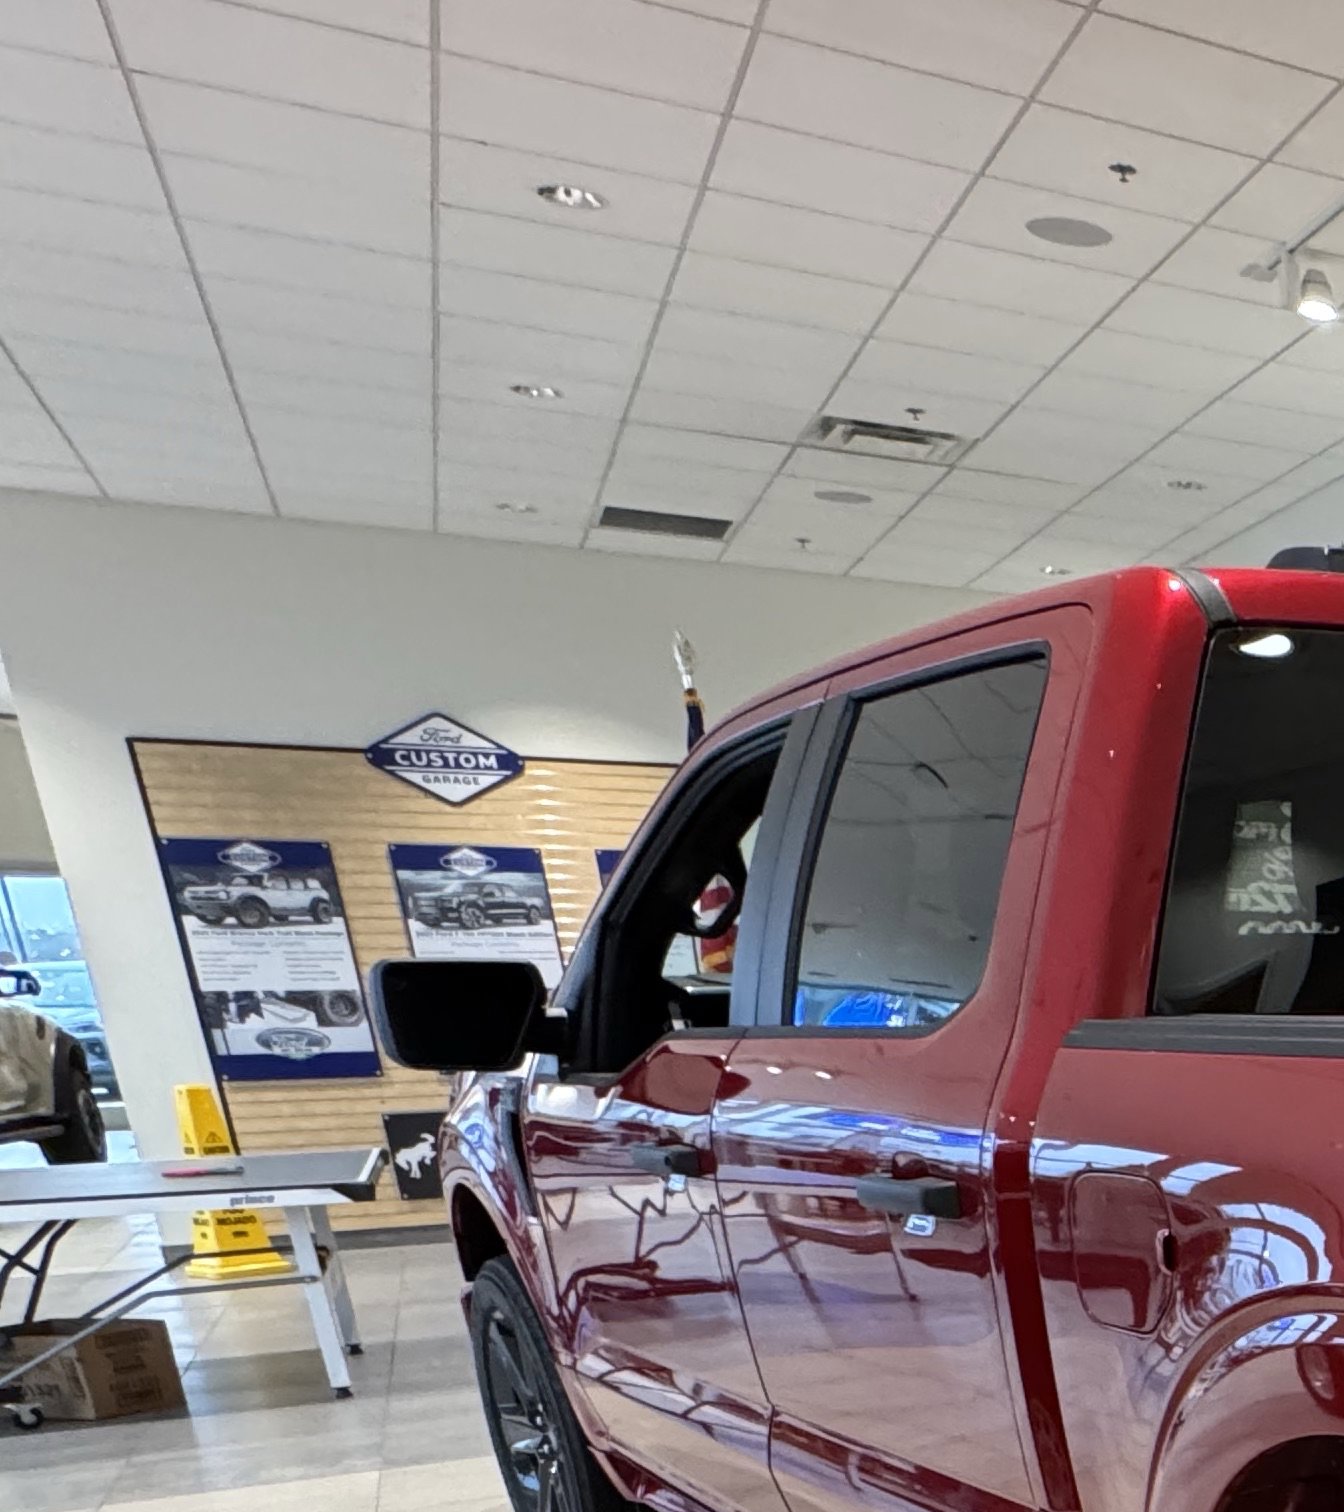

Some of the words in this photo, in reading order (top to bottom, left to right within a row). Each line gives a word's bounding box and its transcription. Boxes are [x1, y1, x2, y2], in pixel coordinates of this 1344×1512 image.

[419, 727, 462, 744] Ford
[394, 750, 499, 770] CUSTOM
[422, 775, 481, 786] GARAGE
